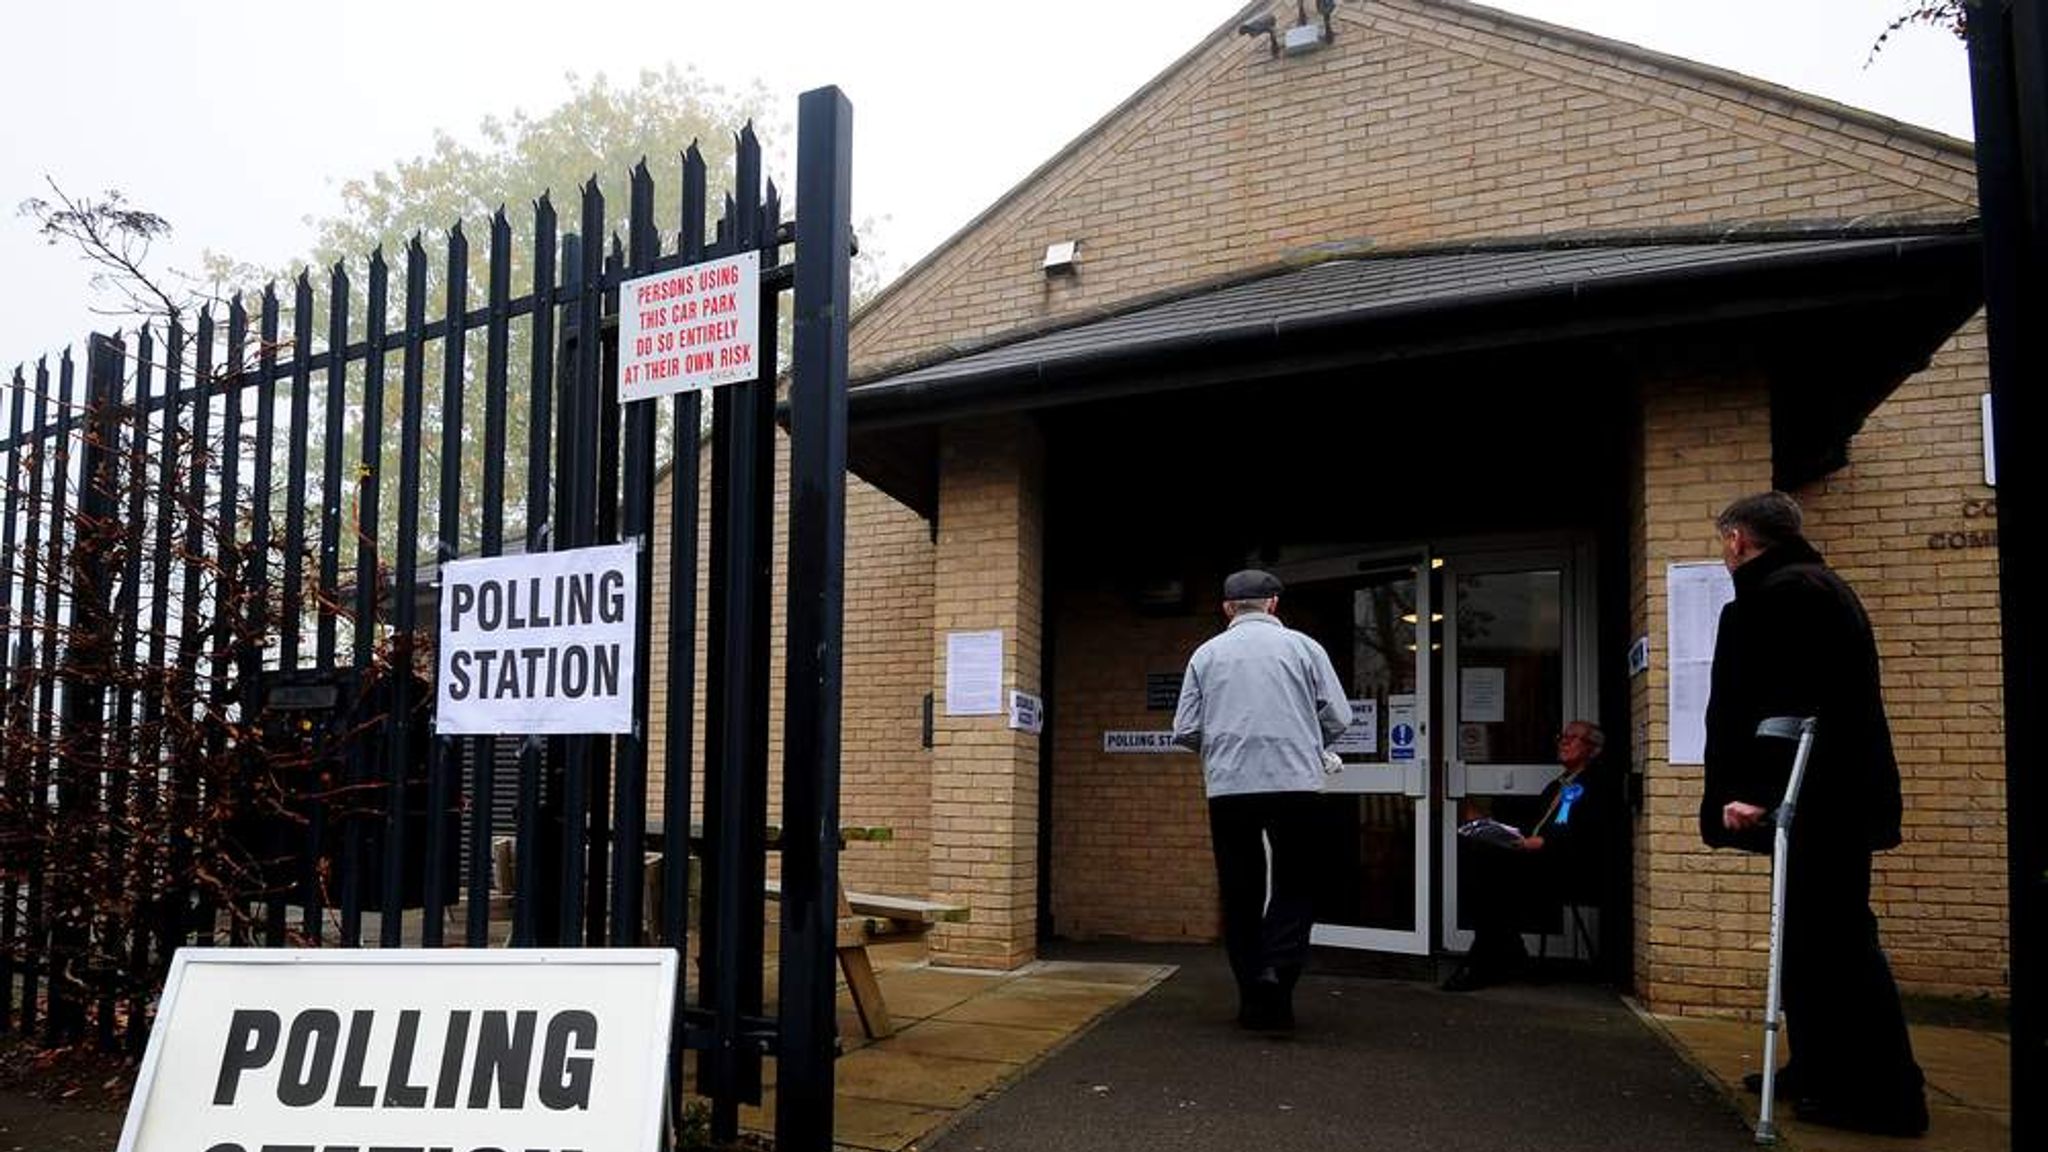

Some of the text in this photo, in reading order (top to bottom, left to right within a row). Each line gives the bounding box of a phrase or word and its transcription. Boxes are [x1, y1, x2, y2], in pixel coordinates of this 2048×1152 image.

[638, 264, 739, 304] PERSONS USING
[640, 292, 736, 329] THIS CAR PARK
[637, 319, 739, 357] DO SO ENTIRELY
[625, 343, 751, 385] AT THEIR OWN RISK
[450, 569, 625, 632] POLLING
[448, 643, 621, 701] STATION
[1108, 735, 1154, 747] POLLING
[212, 1008, 598, 1111] POLLING
